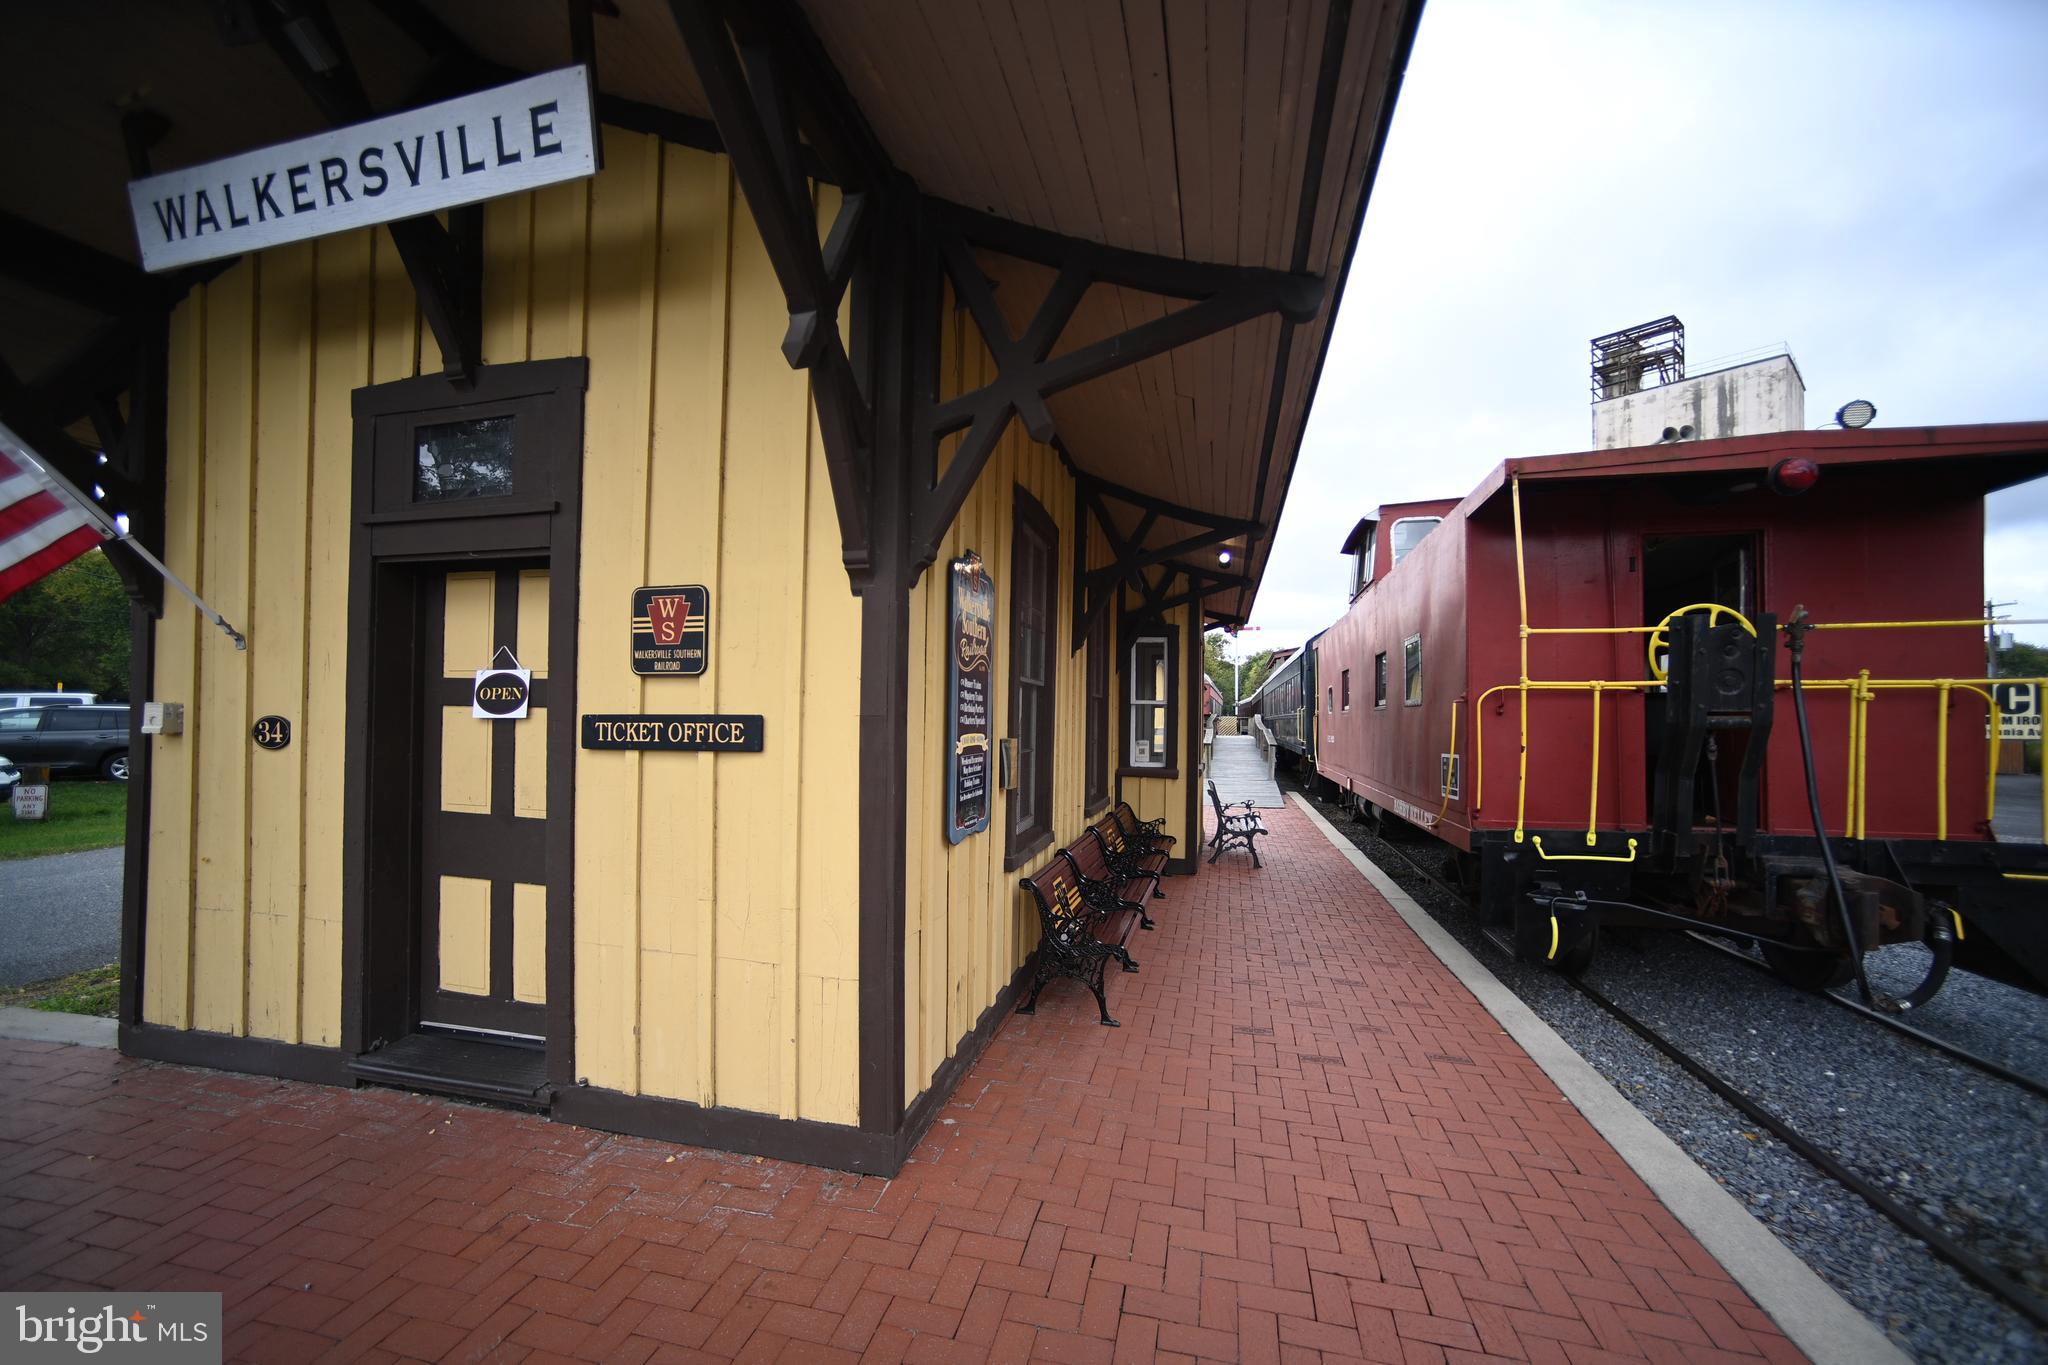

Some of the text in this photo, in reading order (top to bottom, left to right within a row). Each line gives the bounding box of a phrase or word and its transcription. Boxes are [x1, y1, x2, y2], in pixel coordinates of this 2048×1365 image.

[153, 99, 563, 242] WALKERSVILLE
[658, 598, 680, 618] W
[661, 621, 675, 641] S
[961, 609, 987, 641] Southern
[634, 649, 702, 659] WALKERSVILLE SOUTHERN
[960, 637, 989, 661] Railroad
[654, 661, 681, 671] RAILROAD
[480, 687, 523, 700] OPEN
[2017, 716, 2041, 725] IRO
[258, 720, 283, 743] 34
[595, 722, 745, 743] TICKET OFFICE
